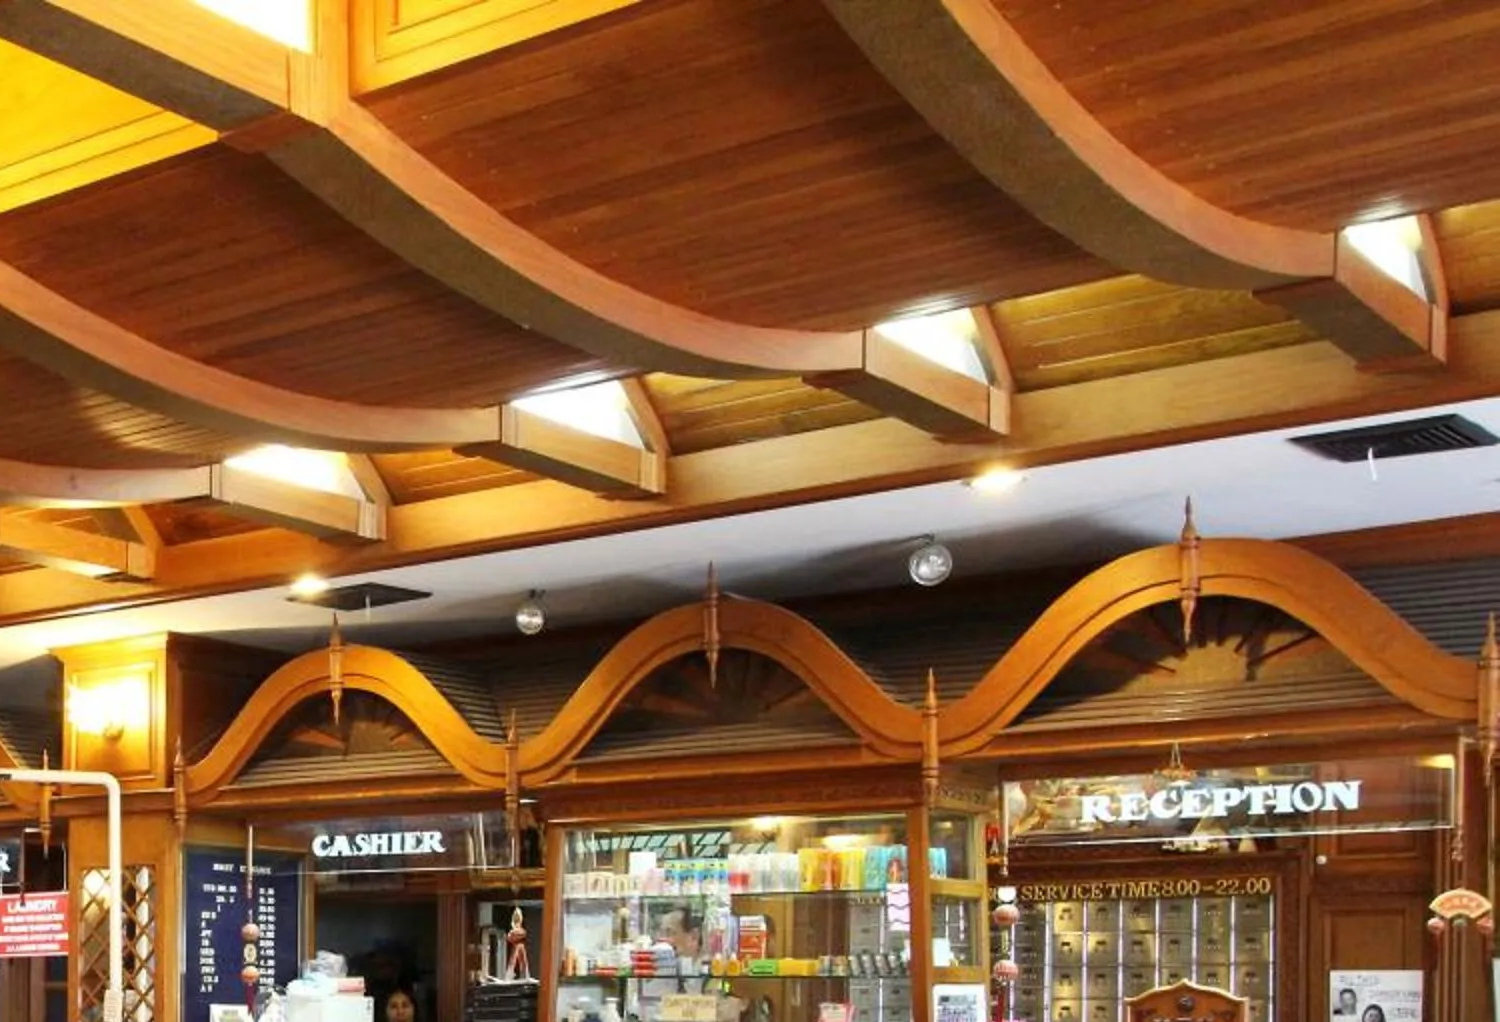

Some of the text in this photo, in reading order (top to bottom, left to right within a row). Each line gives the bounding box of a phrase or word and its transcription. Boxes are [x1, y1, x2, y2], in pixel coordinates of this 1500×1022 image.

[1079, 779, 1363, 824] RECEPTION
[311, 831, 447, 857] CASHIER
[1020, 881, 1104, 901] SERVICE
[1105, 880, 1161, 899] TIME
[1215, 877, 1272, 896] 22.00
